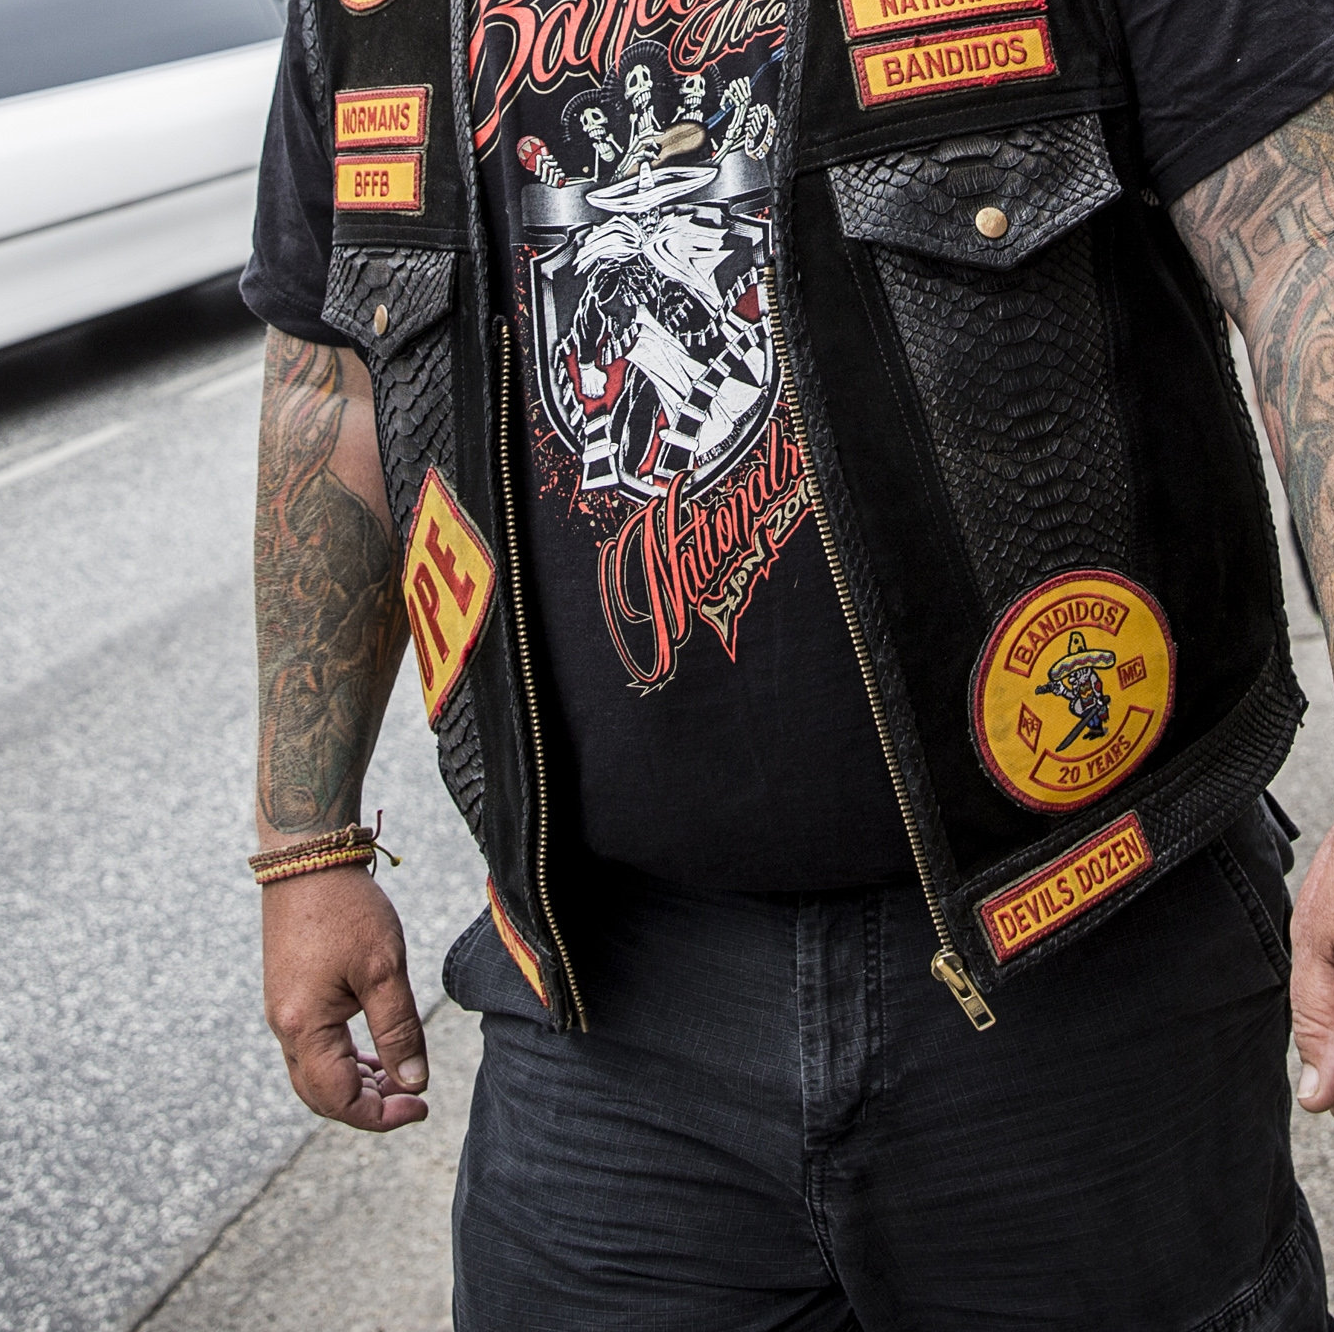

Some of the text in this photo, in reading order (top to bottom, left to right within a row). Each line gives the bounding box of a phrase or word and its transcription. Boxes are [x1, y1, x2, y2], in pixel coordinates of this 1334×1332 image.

[884, 35, 1028, 87] BANDIDOS
[342, 103, 411, 135] NORMANS
[354, 170, 390, 198] BFFB
[1015, 600, 1117, 664] BANDIDOS
[1122, 659, 1144, 686] MC
[1058, 734, 1132, 785] 20 YEARS
[998, 830, 1143, 941] DEVILS DOZEN
